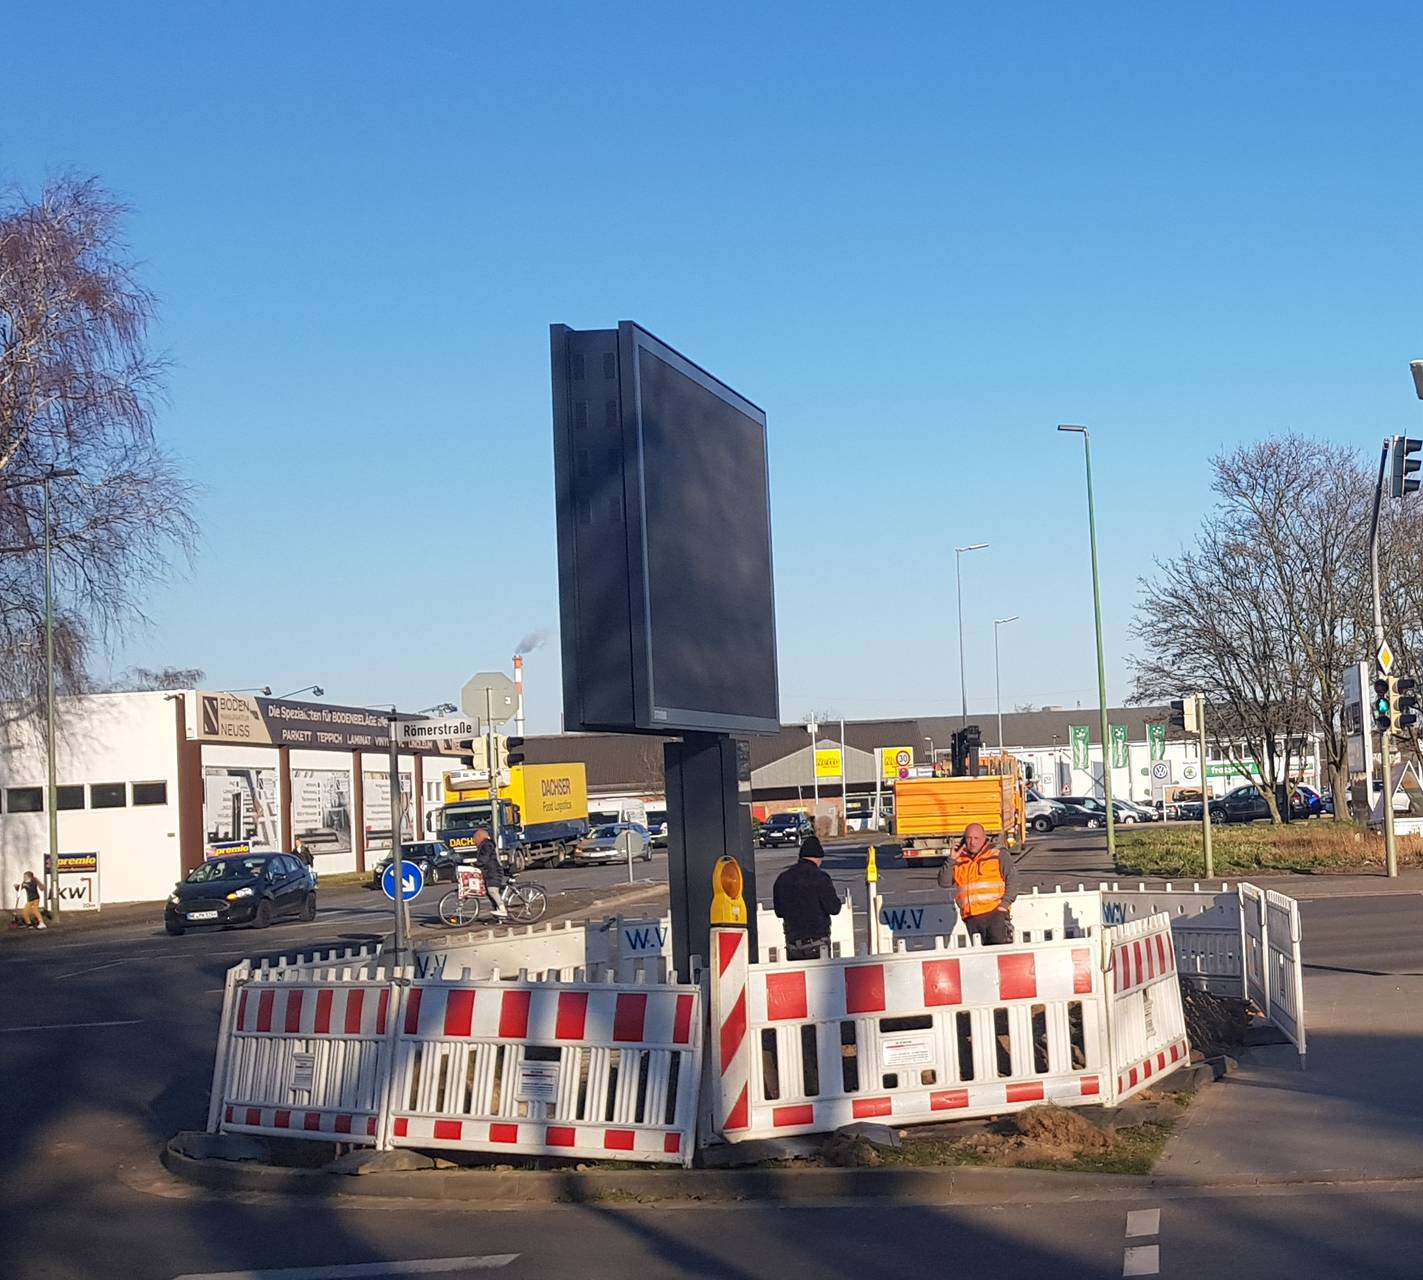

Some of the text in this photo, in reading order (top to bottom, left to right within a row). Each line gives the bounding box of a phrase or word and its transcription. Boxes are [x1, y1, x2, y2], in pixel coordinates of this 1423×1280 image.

[220, 697, 250, 712] BODEN
[268, 704, 280, 717] Die
[332, 711, 376, 727] BODENBELÄGE
[220, 723, 250, 738] NEUSS
[282, 729, 312, 742] PARKETT
[316, 732, 343, 744] TEPPICH
[346, 734, 371, 745] LAMINAT
[403, 722, 472, 737] Römerstraße
[899, 754, 908, 763] 30
[541, 777, 571, 797] DACHSER
[215, 845, 249, 856] premio
